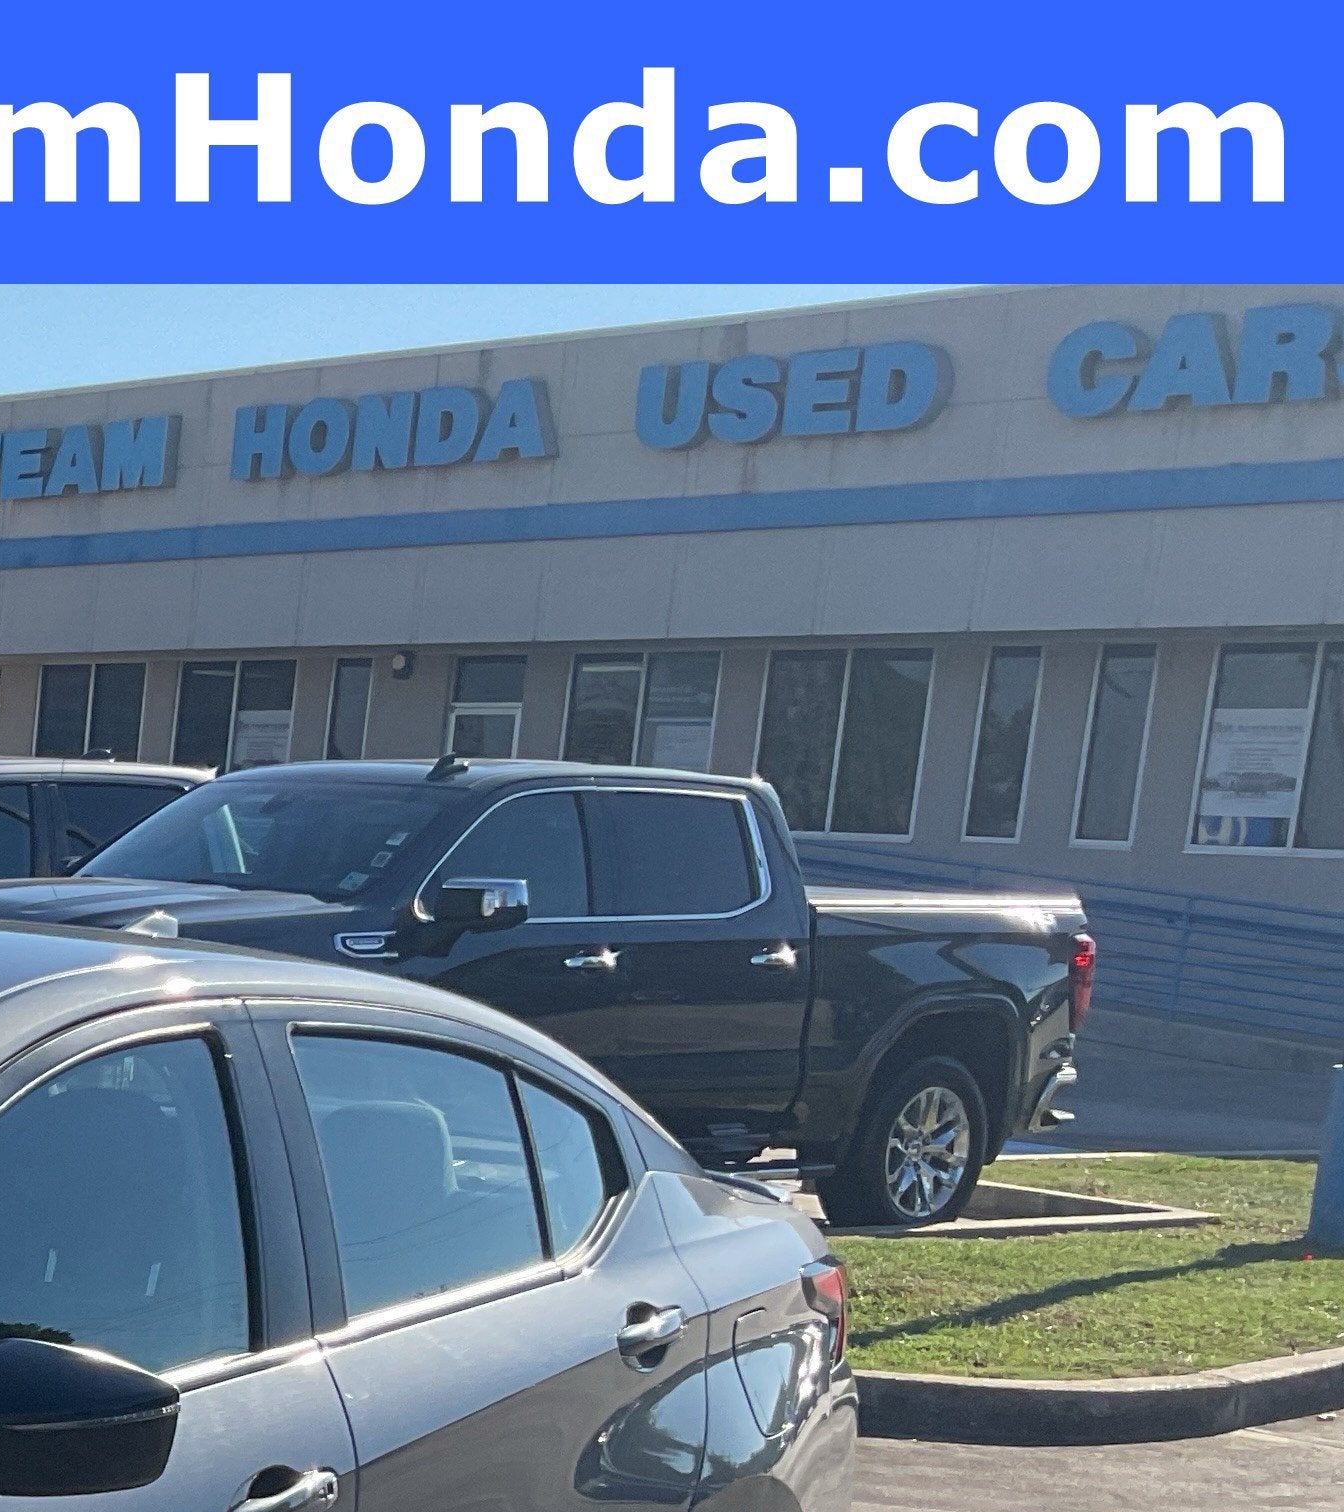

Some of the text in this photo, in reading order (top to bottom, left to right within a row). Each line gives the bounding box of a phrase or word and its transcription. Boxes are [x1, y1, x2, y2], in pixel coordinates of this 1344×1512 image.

[230, 377, 552, 482] HONDA
[634, 338, 946, 452] USED
[1046, 301, 1344, 419] CAR
